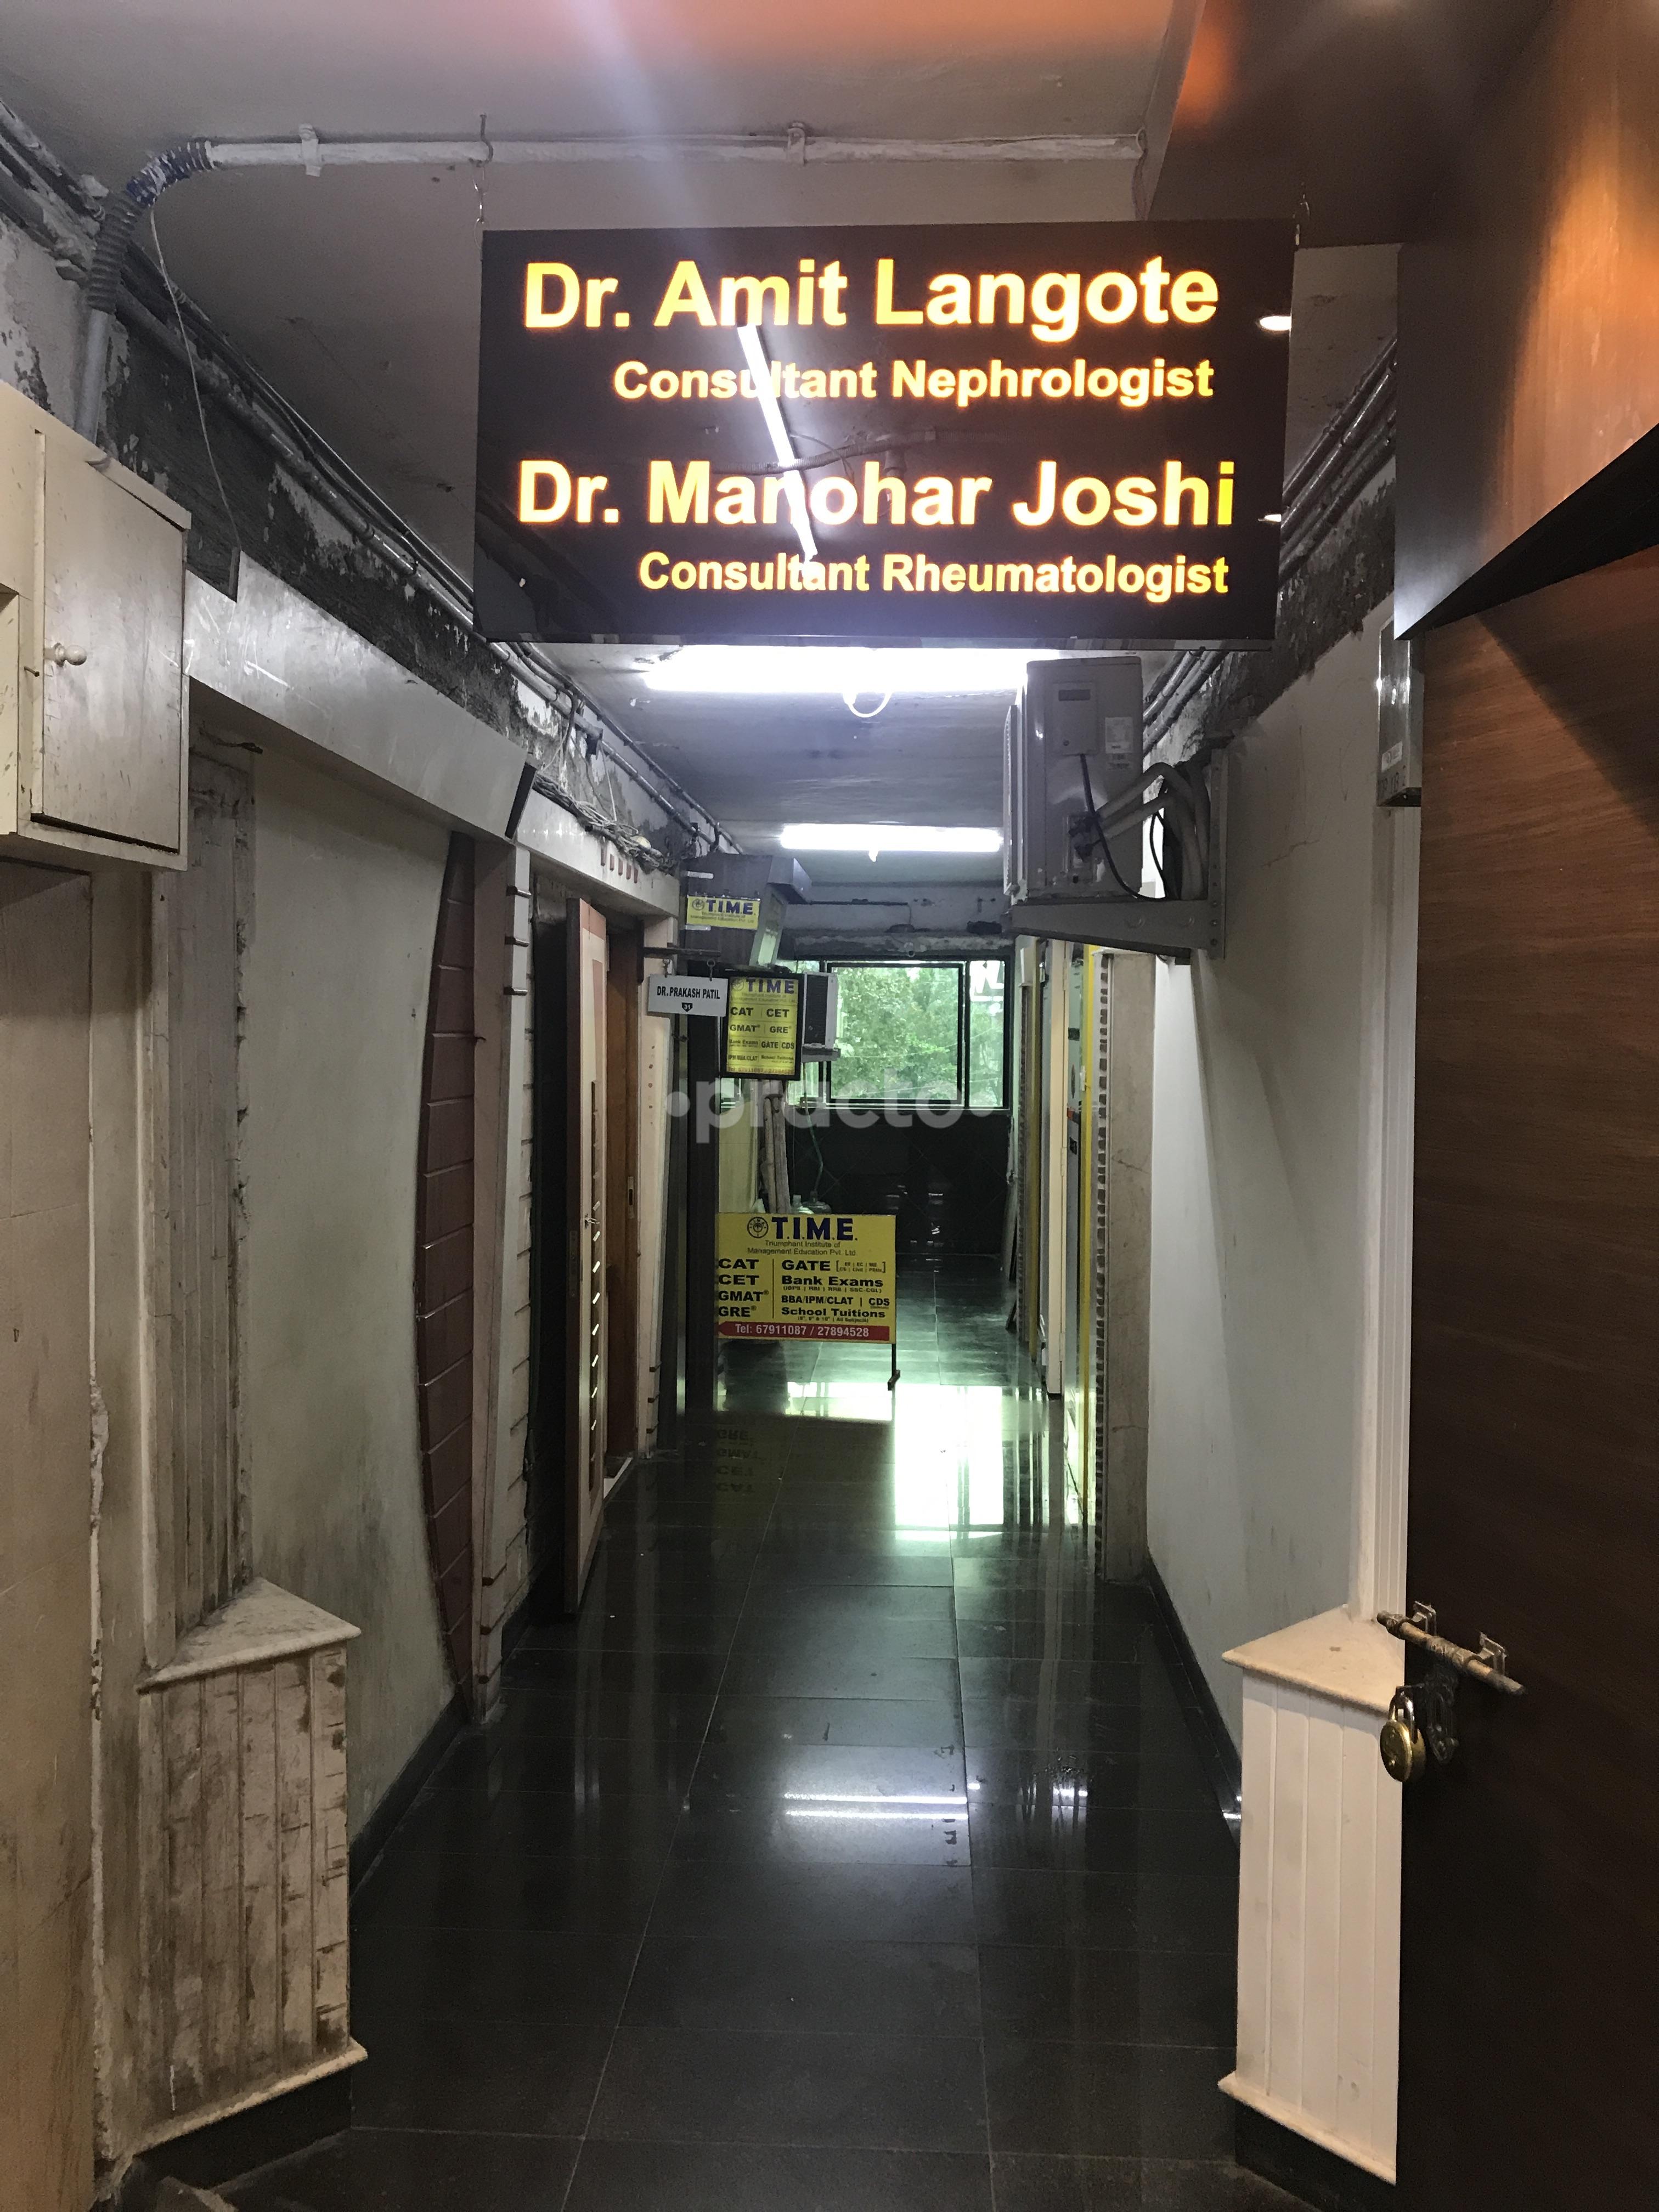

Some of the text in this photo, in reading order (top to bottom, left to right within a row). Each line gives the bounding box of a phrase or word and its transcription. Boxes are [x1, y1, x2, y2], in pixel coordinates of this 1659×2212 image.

[524, 256, 1218, 342] Dr. Amit Langote
[614, 357, 1214, 407] Consultant Nephrologist
[519, 460, 1234, 526] Dr. Manohar Joshi
[639, 551, 1229, 603] Consultant Rheumatologist
[702, 989, 720, 999] PATIL
[730, 1007, 789, 1017] CAT CET
[719, 1258, 759, 1269] CAT
[782, 1260, 831, 1271] GATE
[719, 1274, 759, 1285] CET
[782, 1275, 883, 1287] Bank Exams
[868, 1297, 890, 1306] CDS
[781, 1307, 885, 1318] School Tuitions
[735, 1324, 752, 1334] Tel:
[756, 1324, 806, 1335] 67911087
[817, 1327, 869, 1337] 27894528
